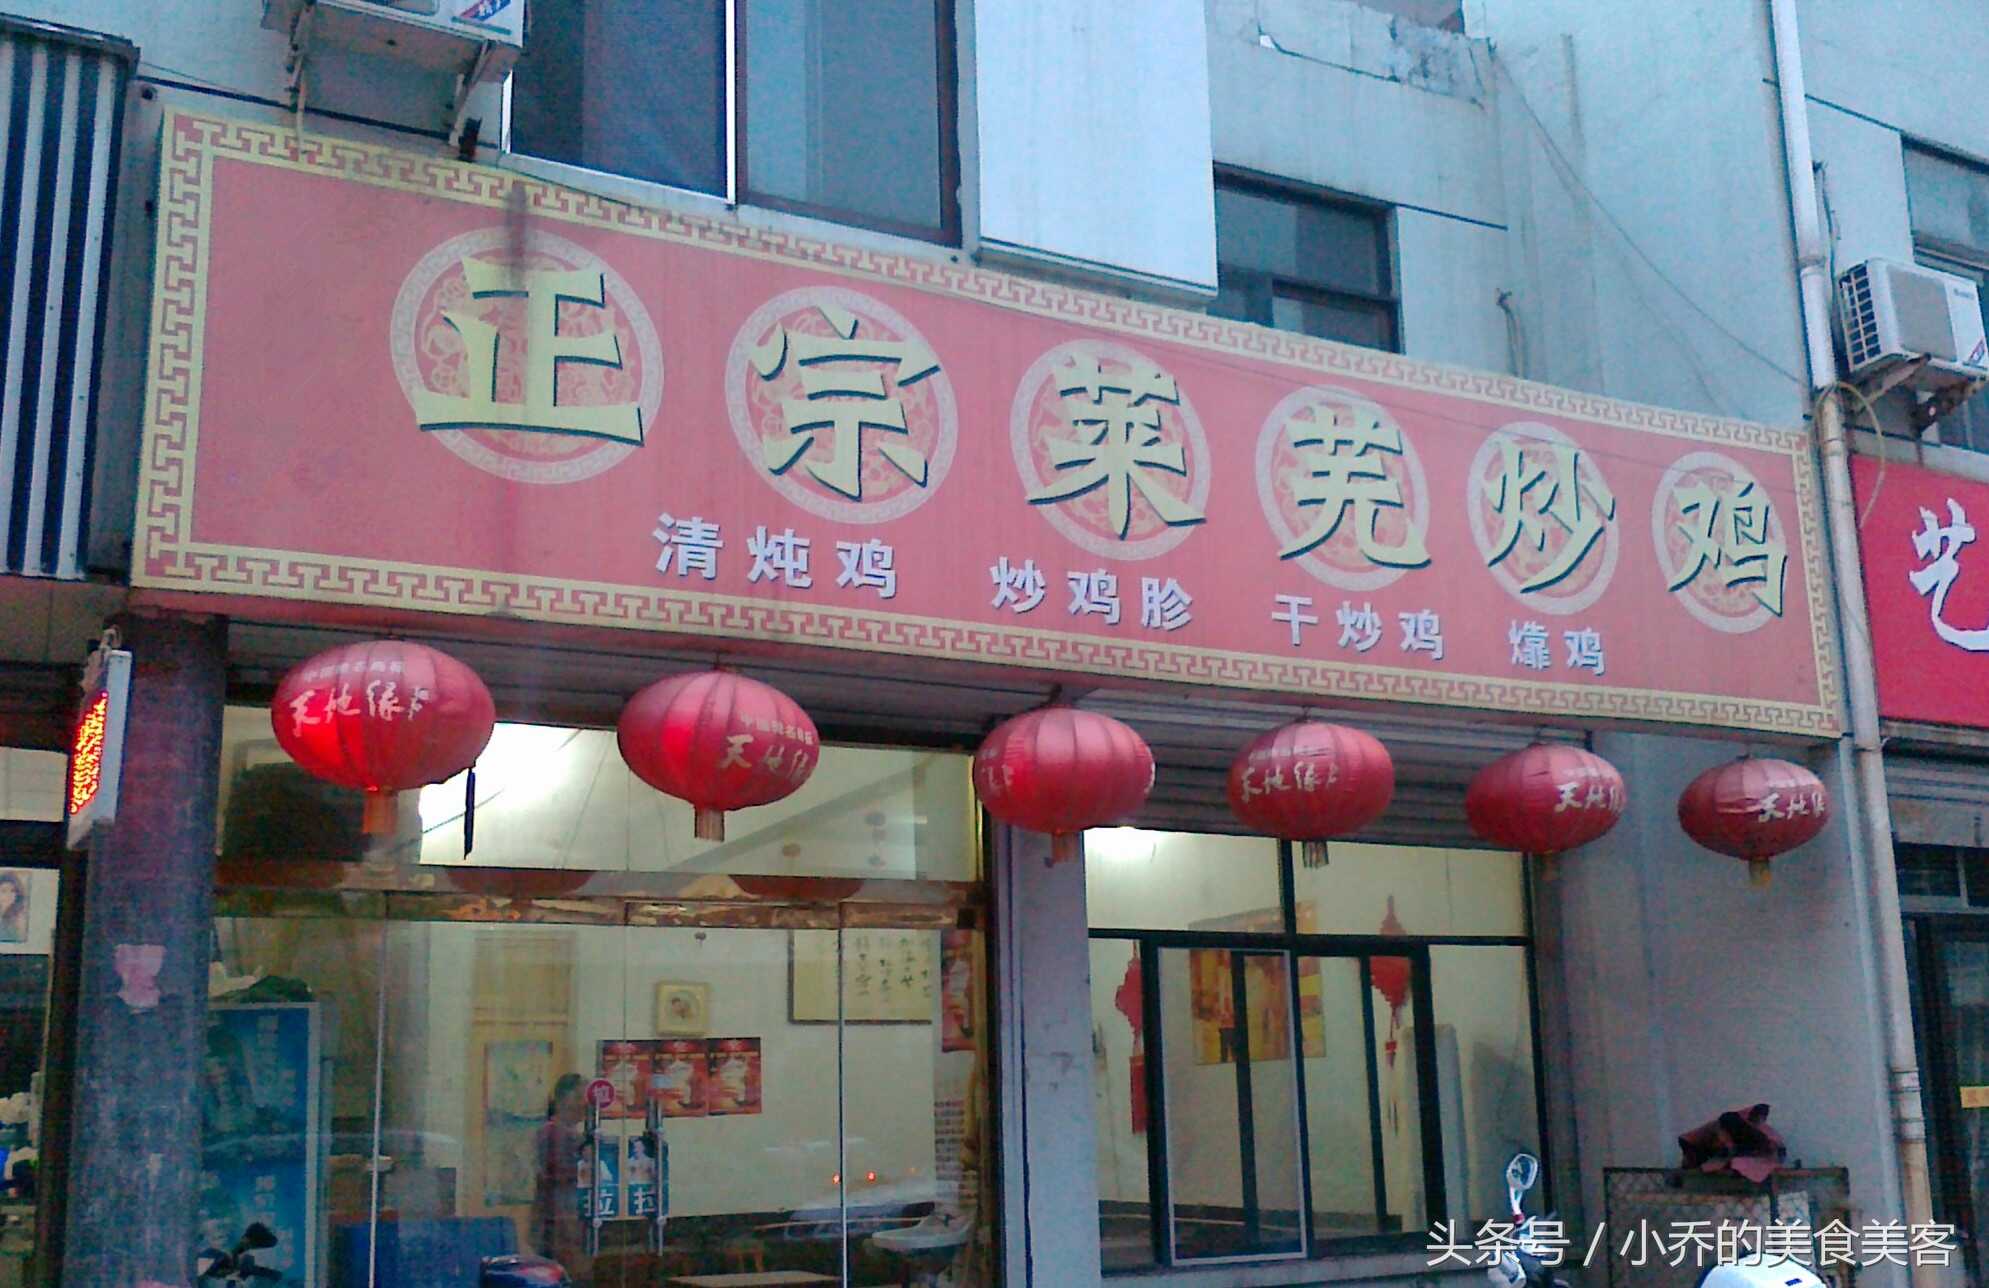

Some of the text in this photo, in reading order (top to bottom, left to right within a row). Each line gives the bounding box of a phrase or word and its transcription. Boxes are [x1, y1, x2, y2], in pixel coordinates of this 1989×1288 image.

[415, 257, 1789, 618] 正宗莱芜炒鸡
[652, 512, 896, 599] 清炖鸡
[989, 556, 1193, 631] 炒鸡胗
[1271, 594, 1444, 661] 干炒鸡
[1909, 497, 1989, 652] 艺
